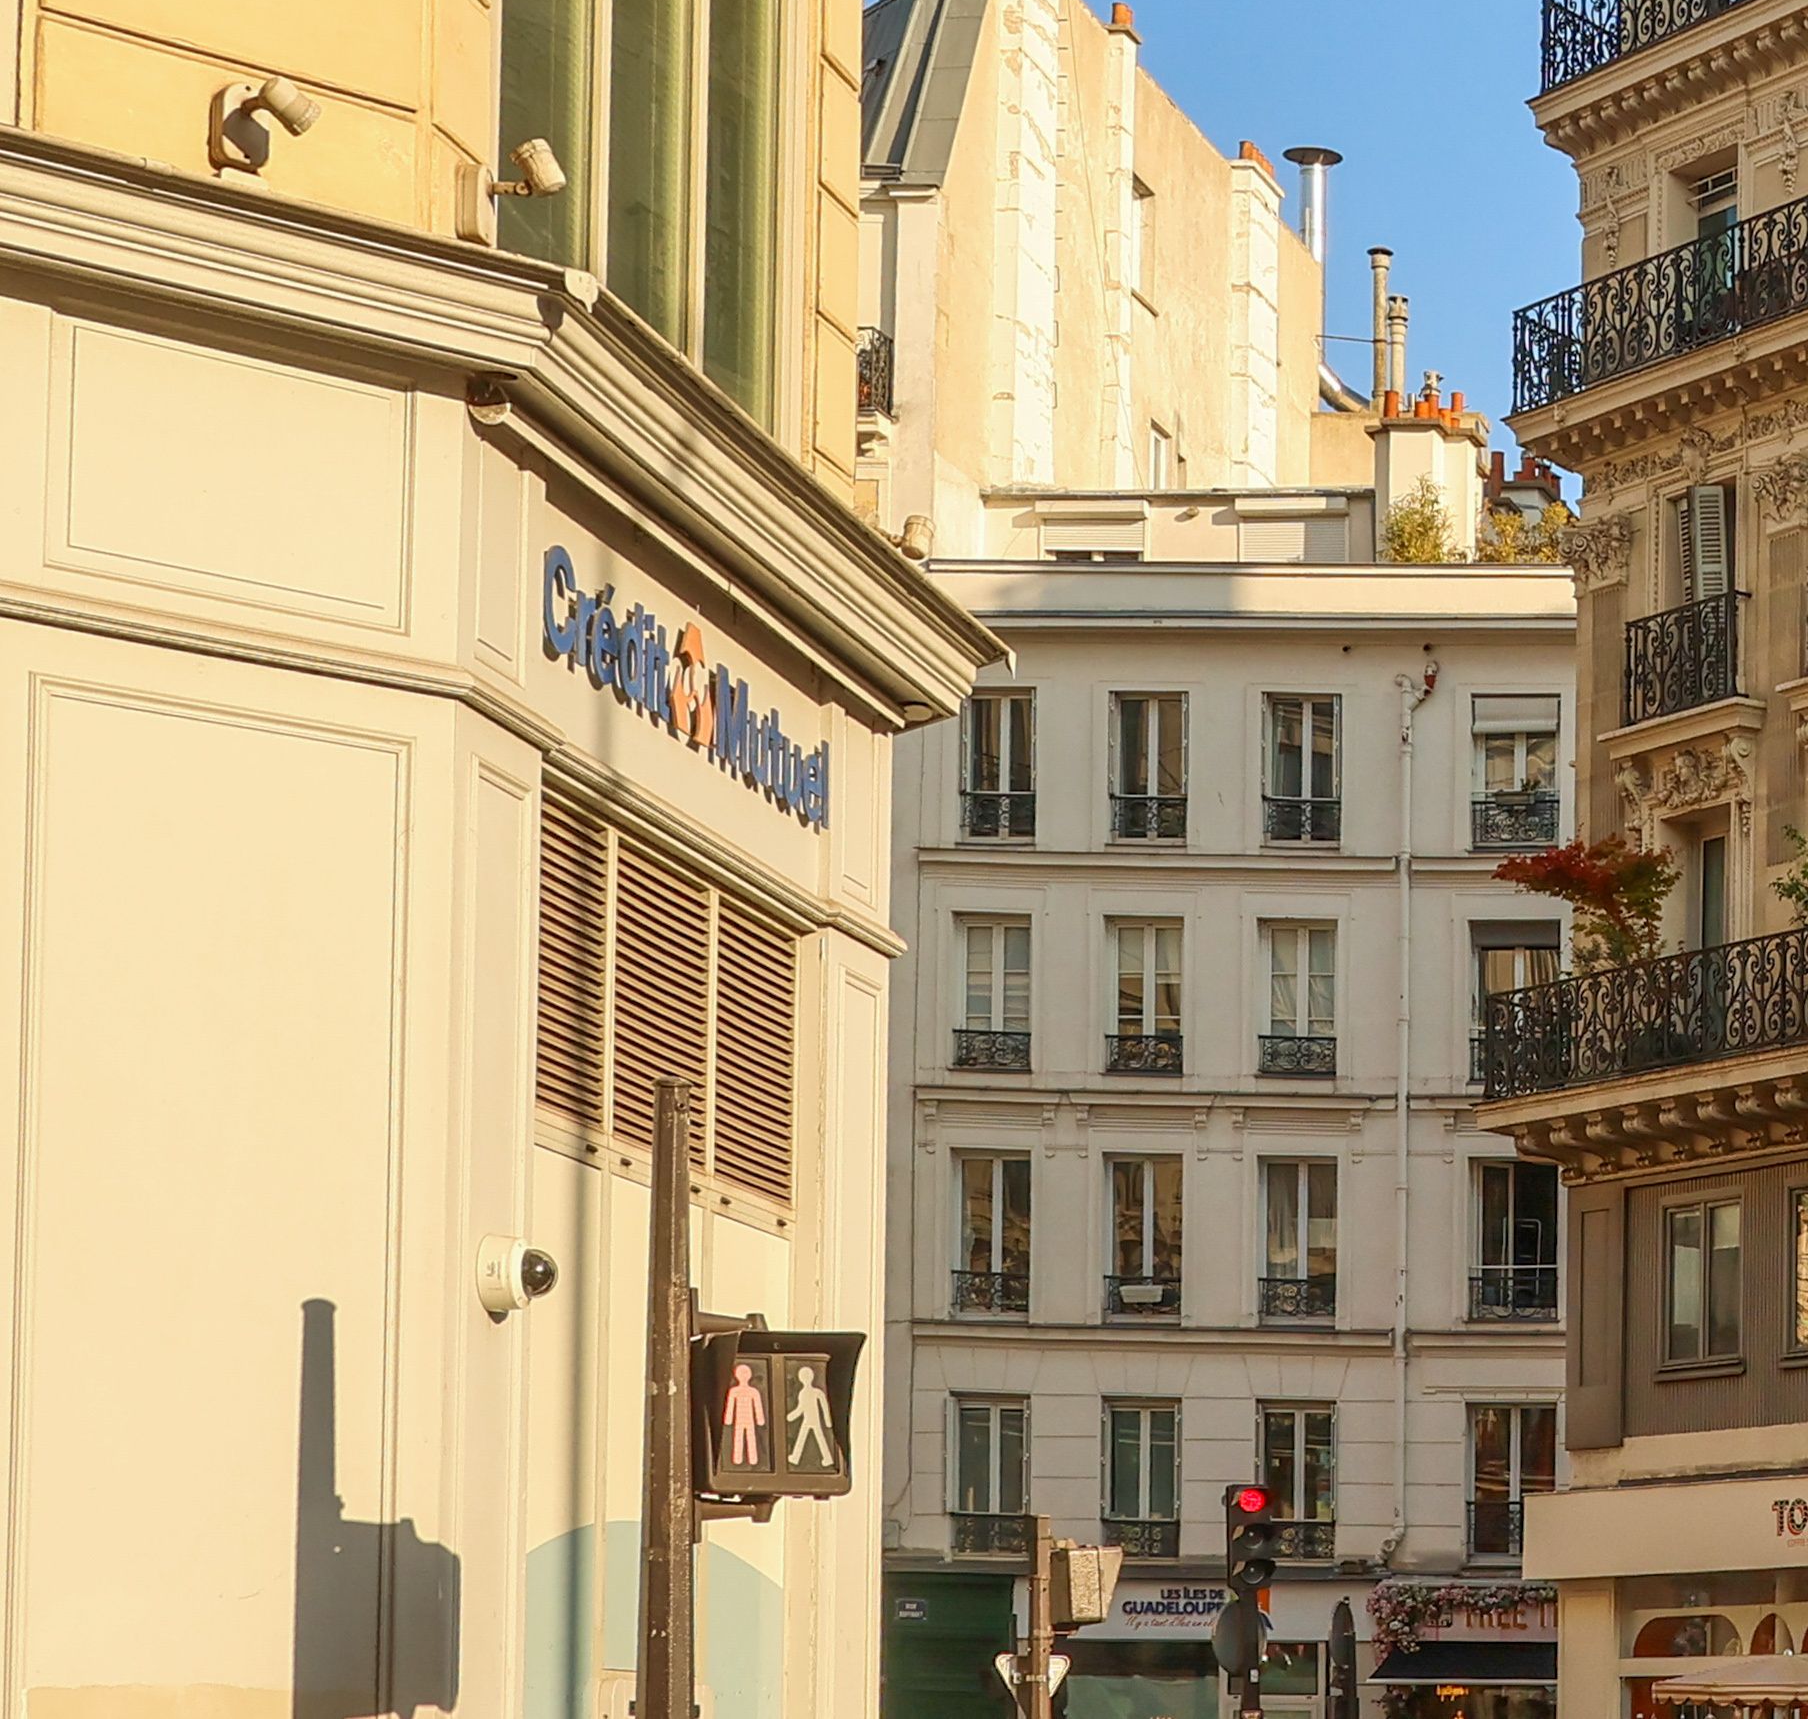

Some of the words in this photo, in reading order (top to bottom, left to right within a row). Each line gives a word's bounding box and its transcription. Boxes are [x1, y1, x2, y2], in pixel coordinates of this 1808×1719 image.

[543, 544, 670, 724] Crédit
[715, 663, 829, 830] Mutuel
[1160, 1588, 1182, 1600] LES
[1183, 1586, 1207, 1600] ÎLES
[1208, 1589, 1226, 1600] DE
